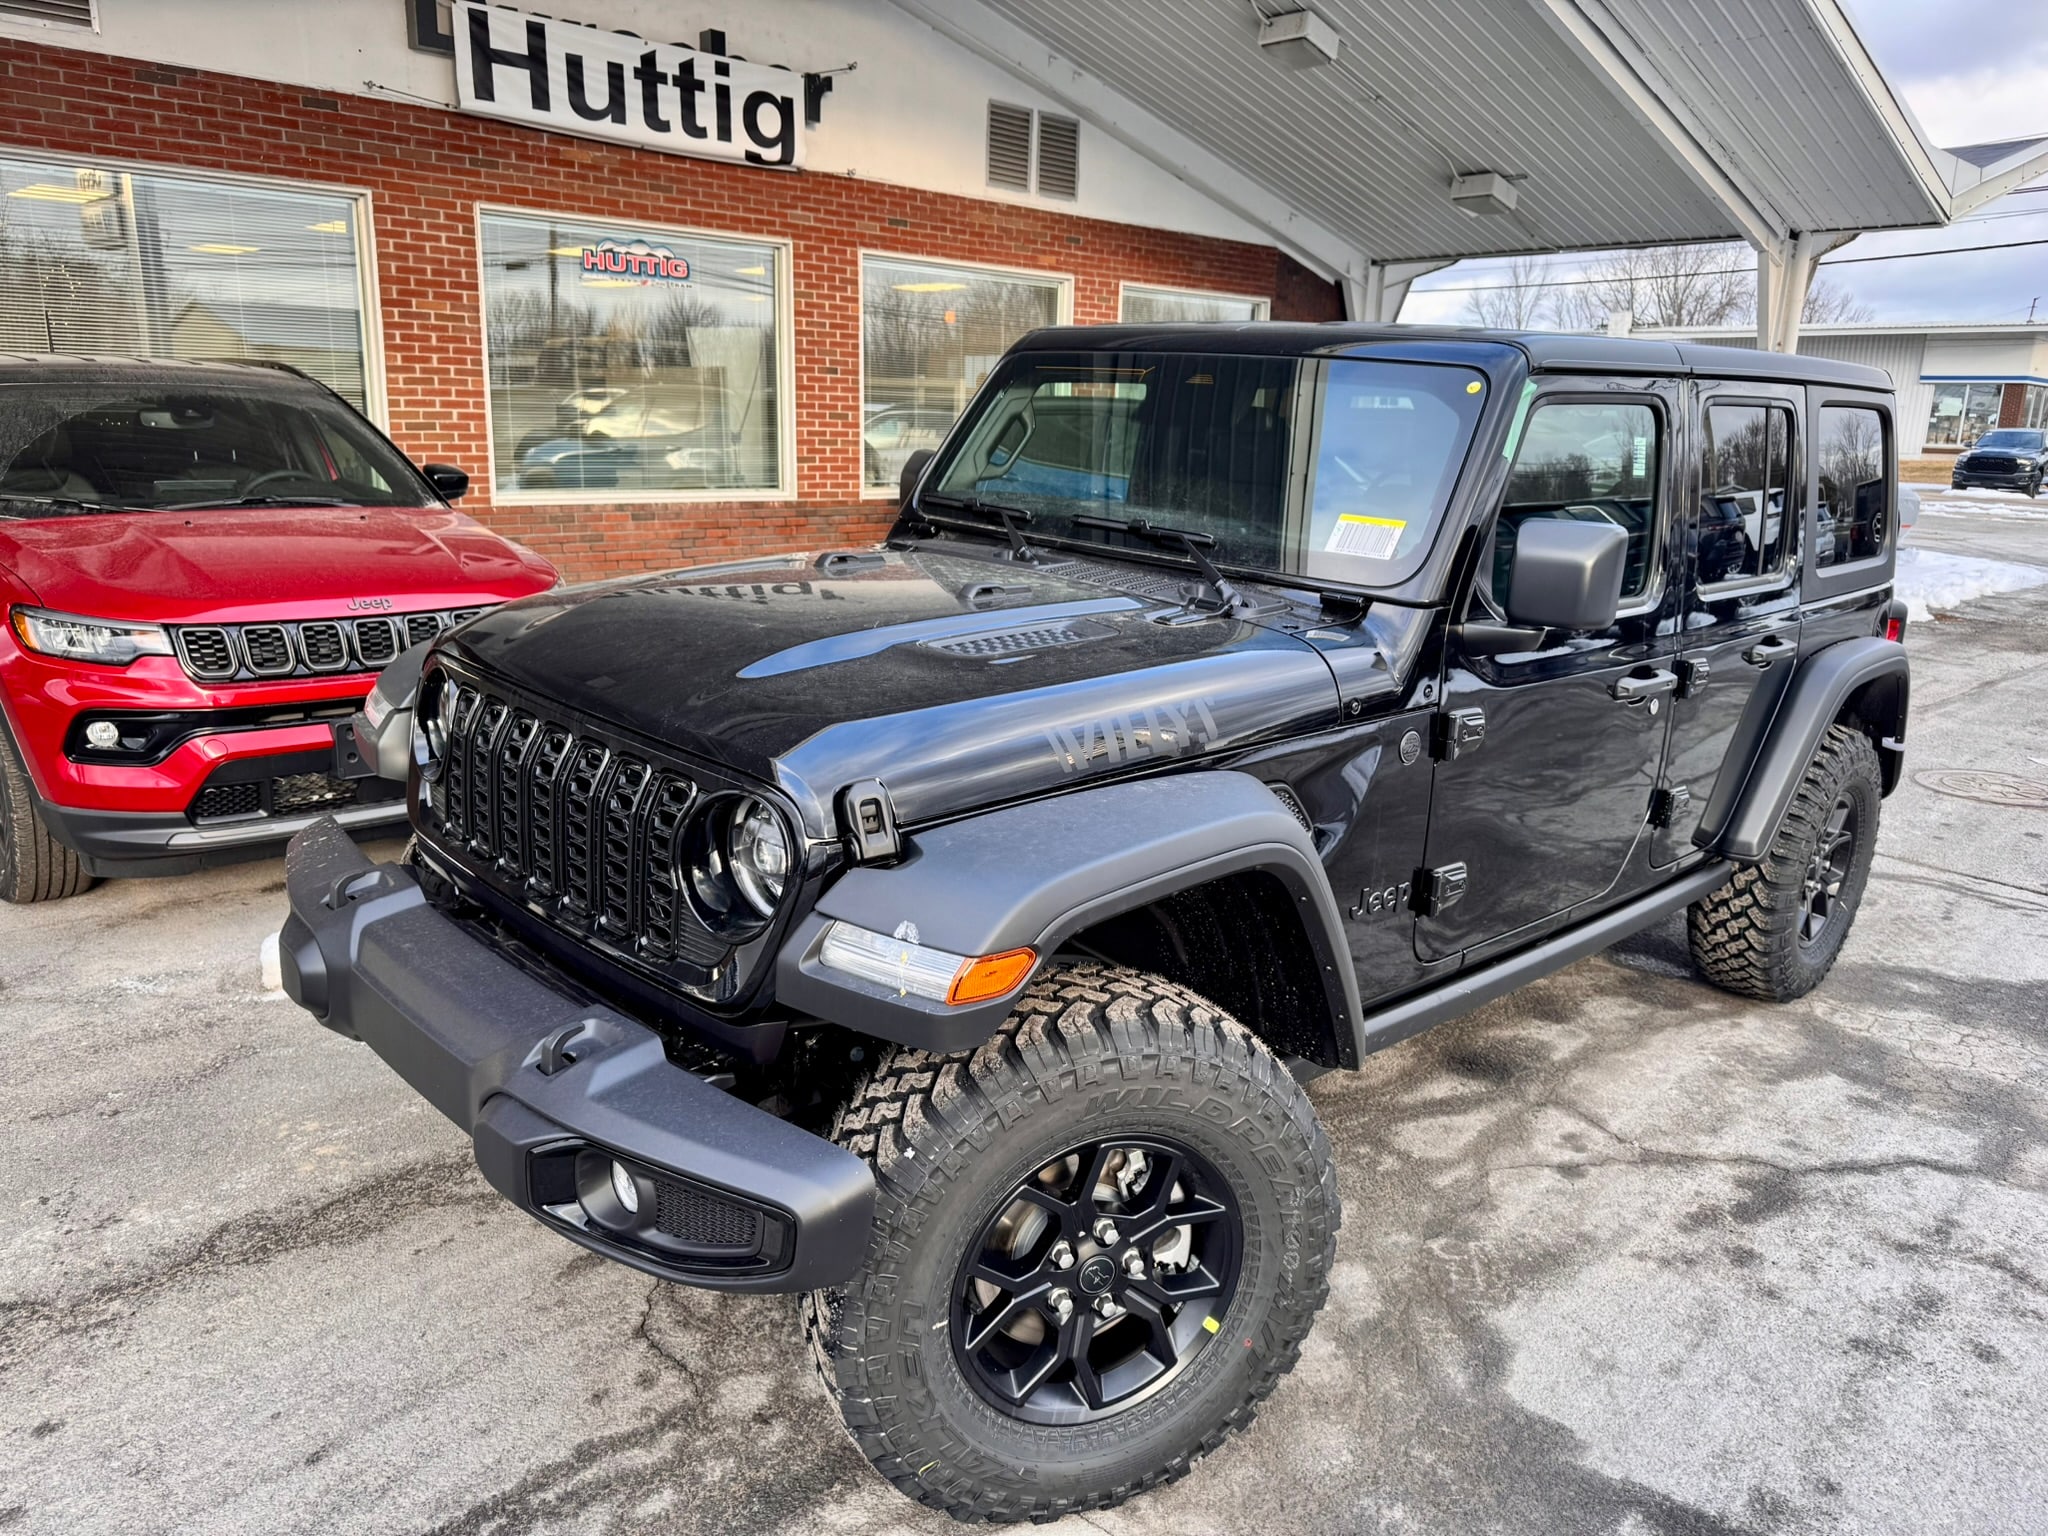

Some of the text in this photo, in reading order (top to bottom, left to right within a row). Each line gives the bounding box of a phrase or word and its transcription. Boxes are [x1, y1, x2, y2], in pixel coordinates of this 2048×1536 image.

[467, 6, 795, 166] Huttig
[582, 248, 689, 279] HUTTIG
[347, 597, 393, 611] Jeep
[1349, 881, 1412, 920] Jeep
